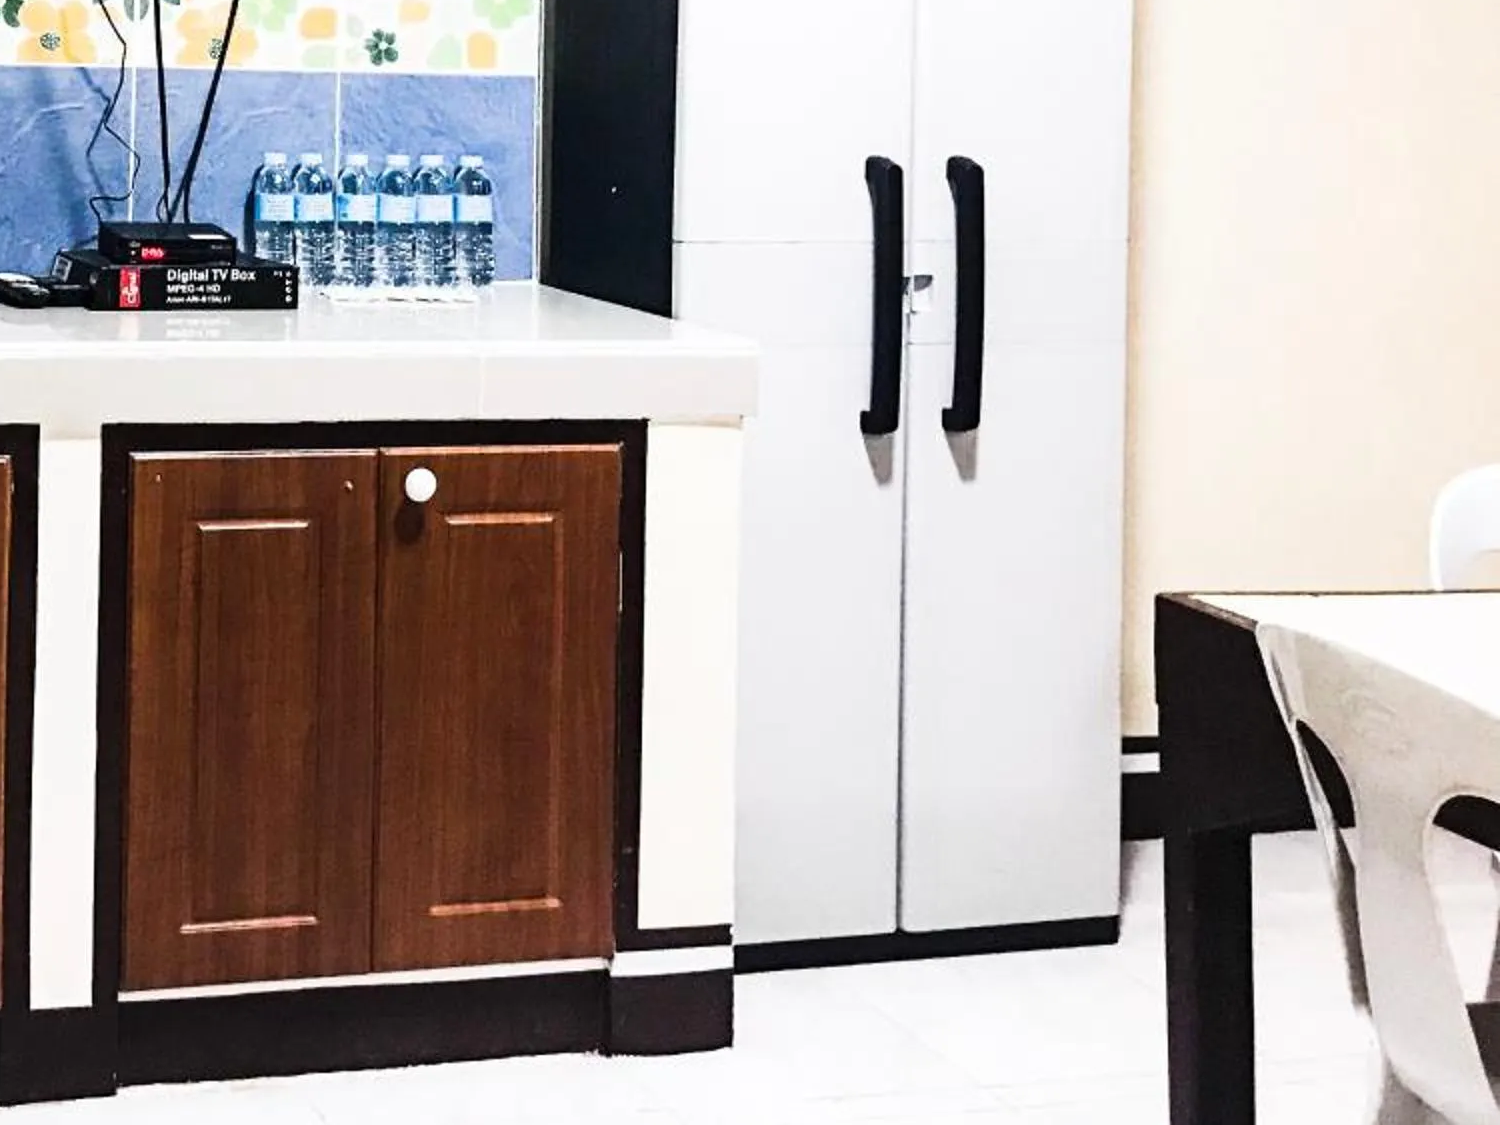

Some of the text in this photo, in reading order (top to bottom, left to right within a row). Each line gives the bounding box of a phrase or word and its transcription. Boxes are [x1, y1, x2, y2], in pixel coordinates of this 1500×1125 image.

[167, 268, 256, 284] Digital TV Box
